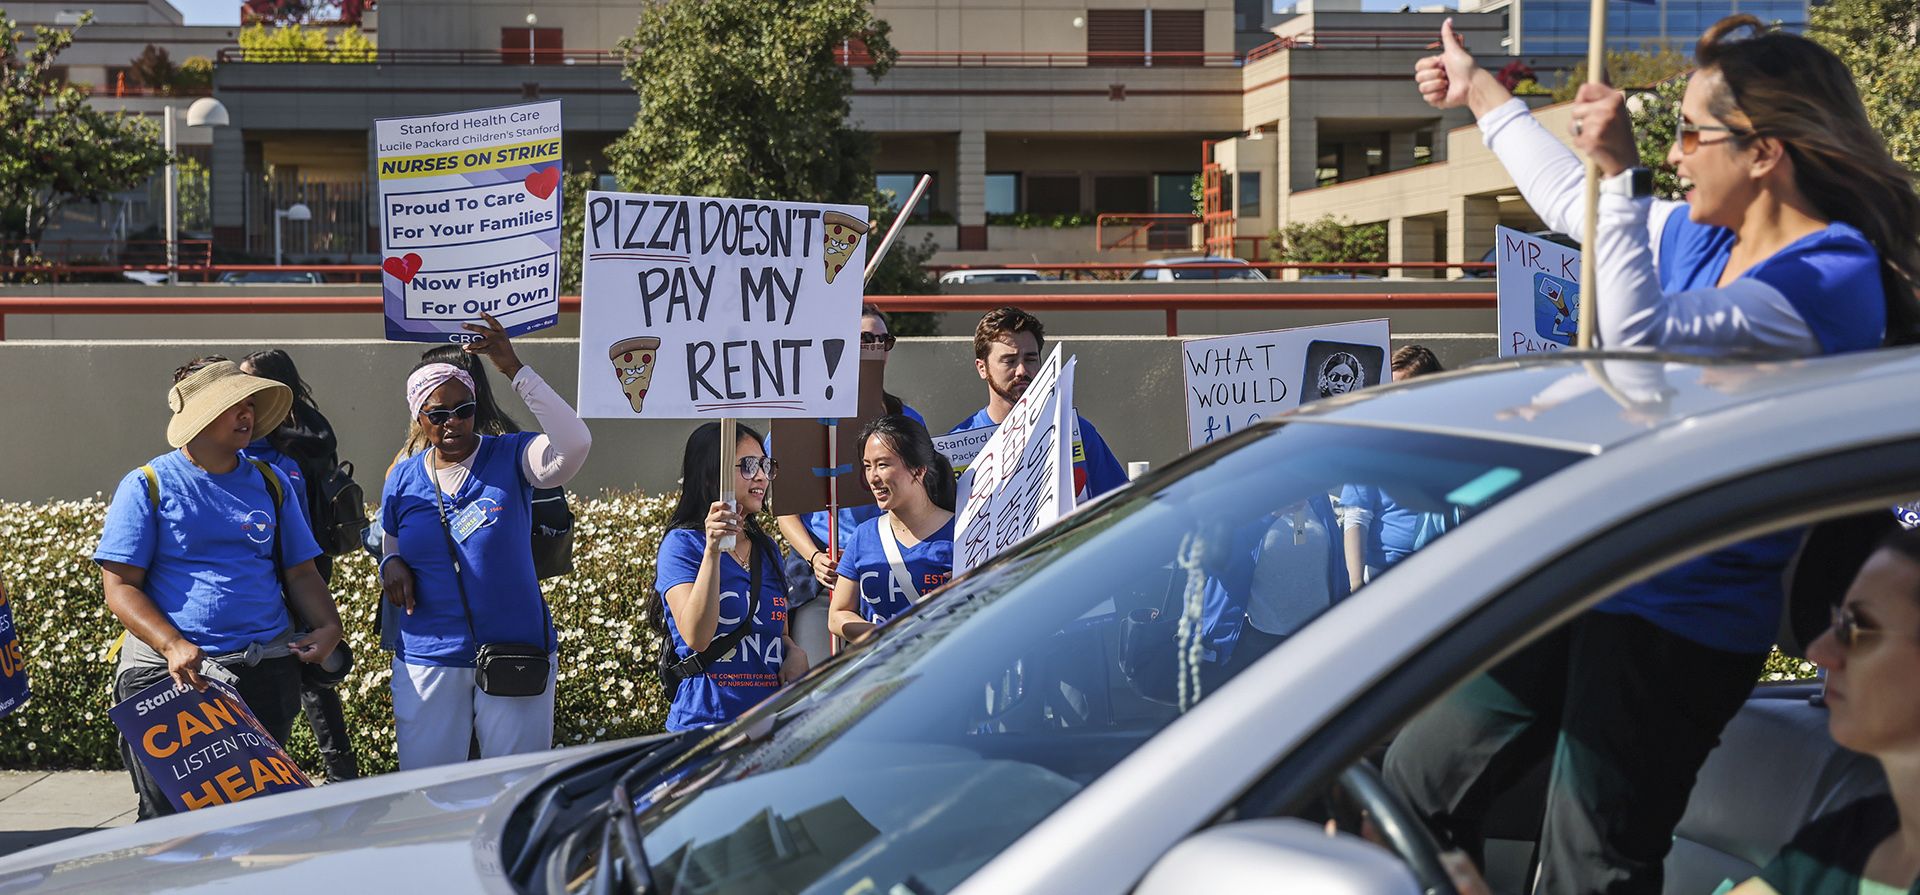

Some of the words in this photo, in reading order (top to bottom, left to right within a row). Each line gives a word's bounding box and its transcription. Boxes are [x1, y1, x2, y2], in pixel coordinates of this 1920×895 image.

[379, 140, 412, 152] Lucile
[415, 136, 459, 149] Packard
[462, 130, 514, 145] Children's
[516, 123, 560, 138] Stanford
[400, 120, 459, 135] Stanford
[463, 115, 507, 129] Health
[510, 110, 540, 122] Care
[381, 155, 459, 175] NURSES
[463, 151, 492, 168] ON
[496, 141, 560, 164] STRIKE
[391, 199, 450, 216] Proud
[455, 197, 479, 211] To
[484, 191, 526, 208] Care
[392, 226, 425, 239] For
[429, 222, 474, 237] Your
[480, 209, 553, 232] Families
[589, 197, 691, 254] PIZZA
[699, 201, 821, 258] DOESN'T
[1506, 234, 1550, 272] MR.
[412, 275, 461, 291] Now
[468, 262, 550, 289] Fighting
[422, 301, 456, 314] For
[463, 298, 501, 314] Our
[507, 287, 549, 307] Own
[638, 265, 716, 327] PAY
[740, 266, 803, 326] MY
[1186, 344, 1275, 376] WHAT
[1192, 377, 1287, 408] WOULD
[937, 432, 988, 451] Stanford
[773, 597, 785, 606] ES
[136, 681, 194, 716] Stanfo
[172, 736, 239, 780] LISTEN
[237, 732, 260, 748] TO
